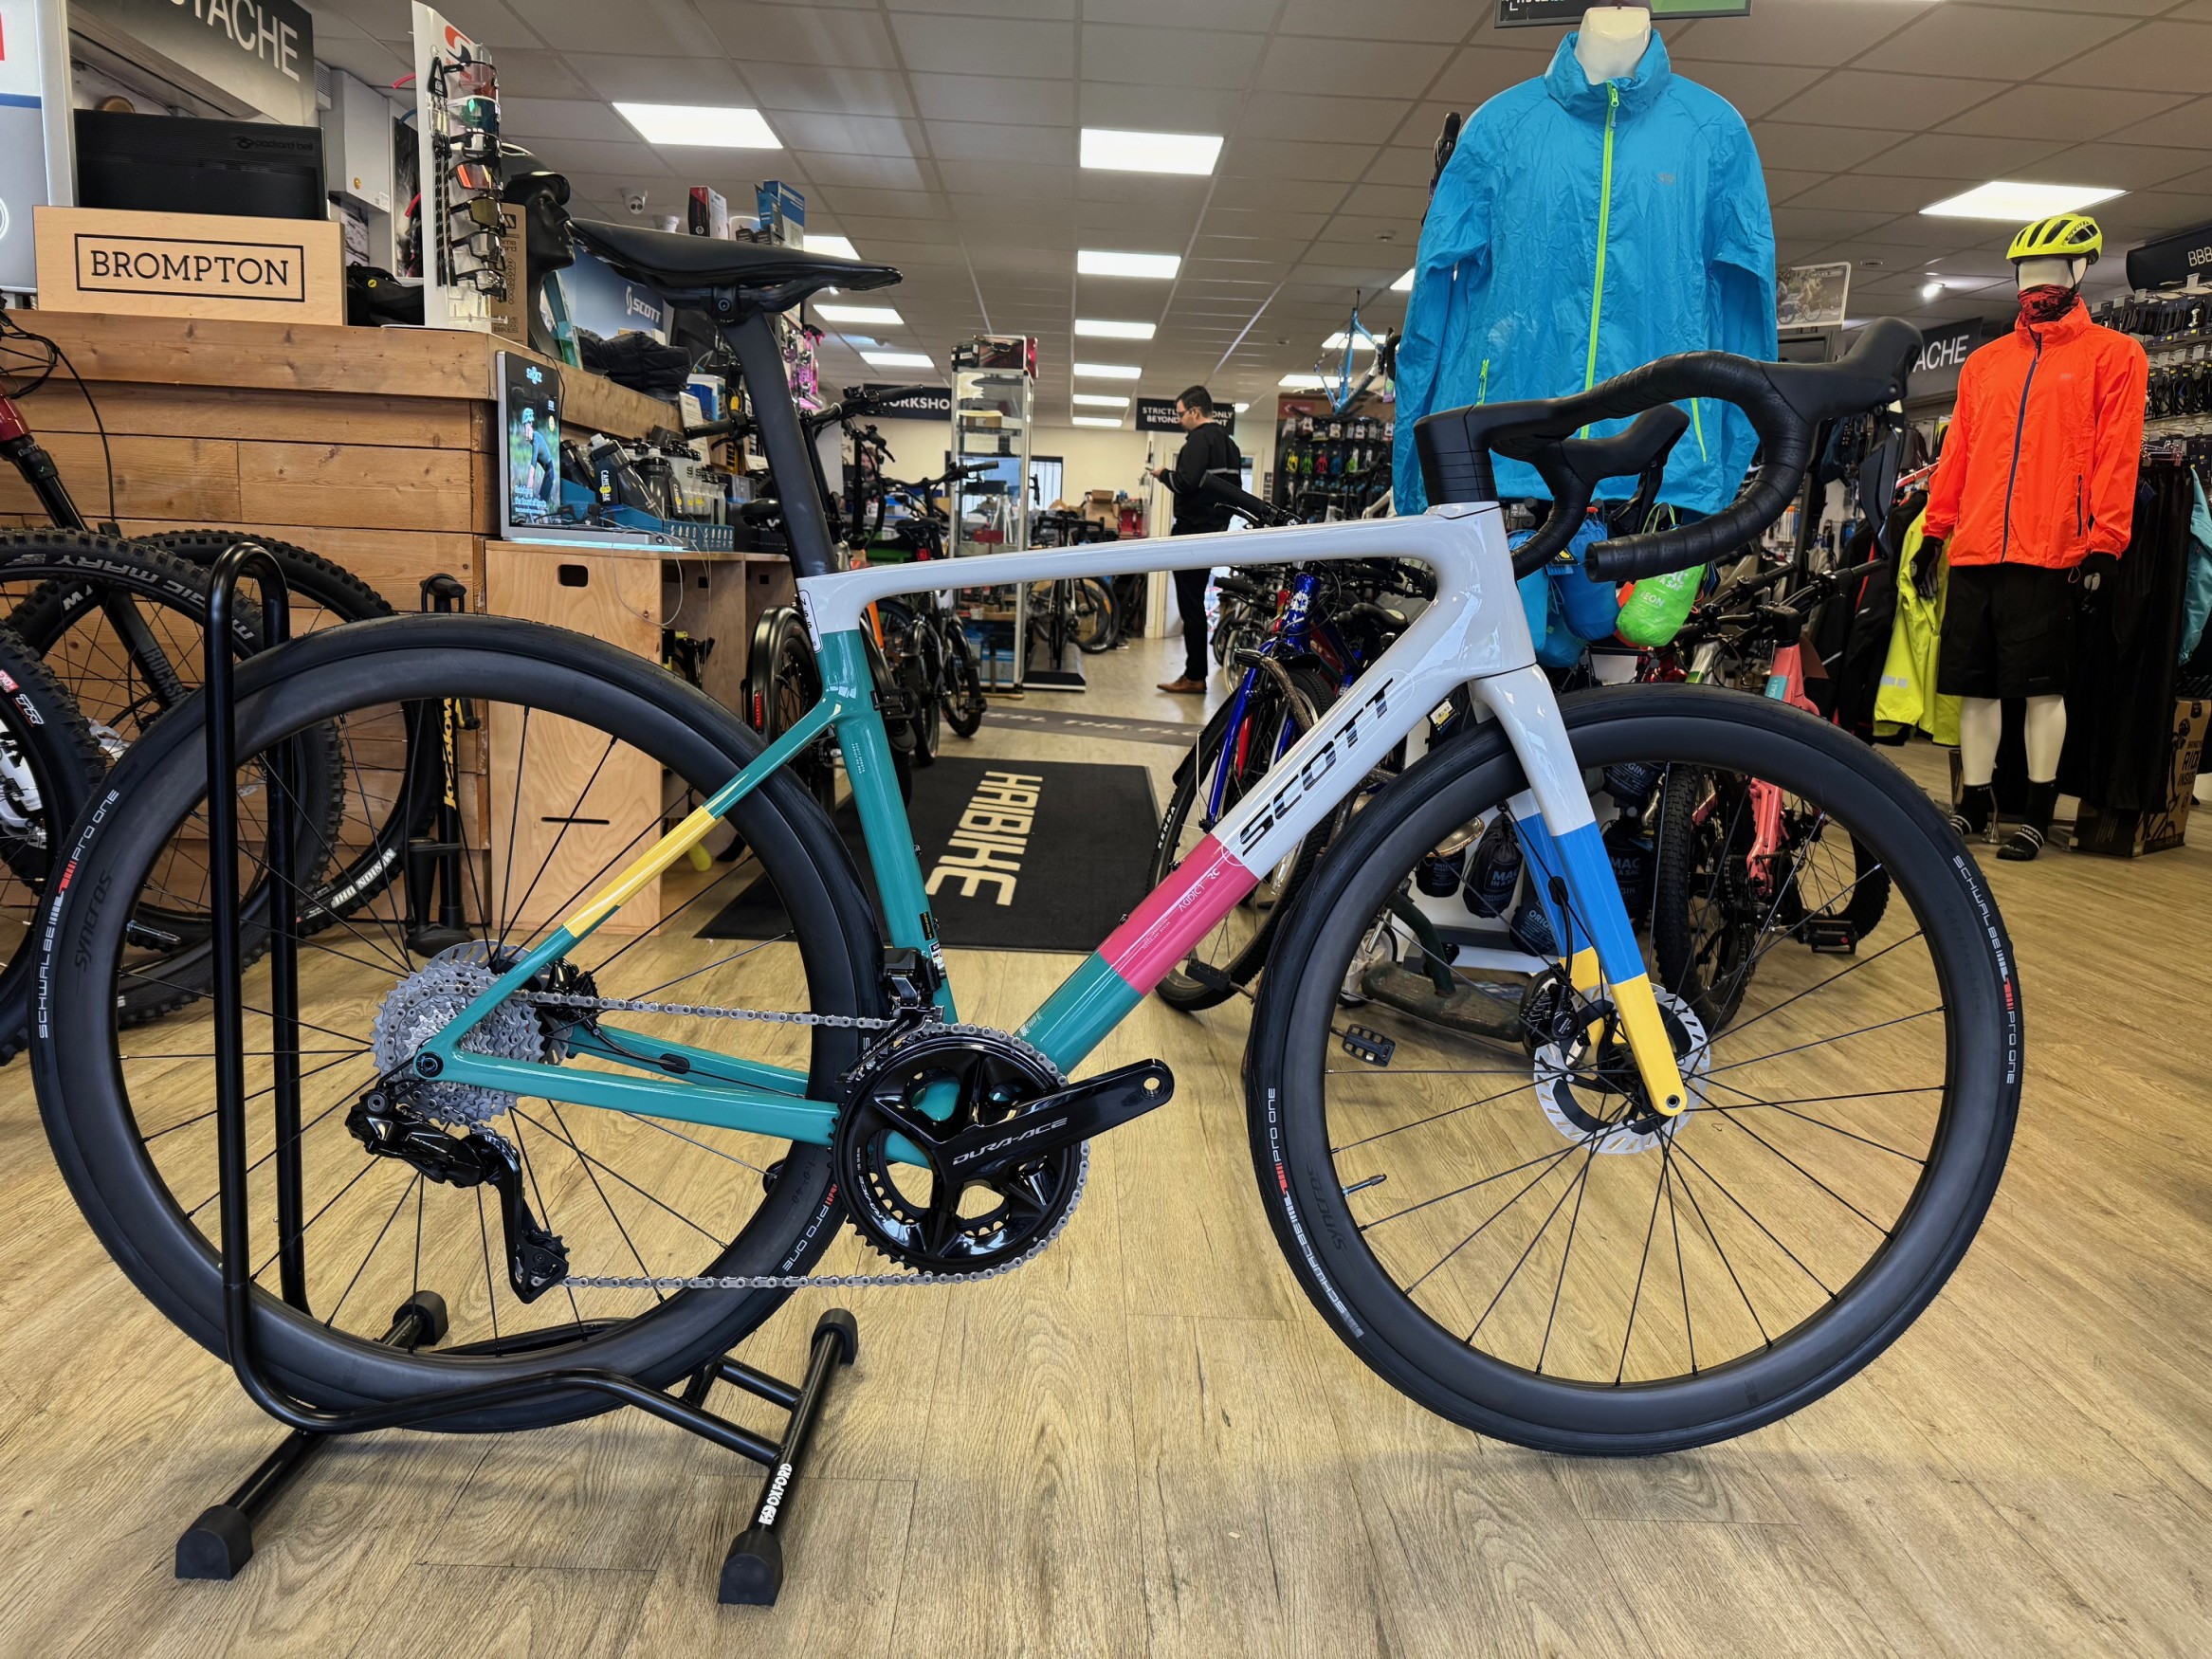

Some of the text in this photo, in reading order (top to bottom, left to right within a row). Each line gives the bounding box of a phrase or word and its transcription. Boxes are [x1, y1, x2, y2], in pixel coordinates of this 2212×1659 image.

[91, 249, 289, 285] BROMPTON
[632, 298, 661, 323] SCOTT
[54, 554, 254, 641] MGIC MARY
[1239, 677, 1394, 857] SCOTT
[72, 789, 120, 862] PRO ONE
[925, 771, 1043, 906] HAIBIKE
[1158, 806, 1176, 849] KENDA
[74, 868, 113, 973] SYNCROS
[1178, 867, 1220, 912] ADDICT RC
[39, 925, 57, 1039] SCHWALBE
[1953, 854, 2017, 1085] SCHWALBE PRO ONE
[952, 1117, 1069, 1166] DURA-ACE
[1268, 1087, 1282, 1163] PRO ONE
[782, 1204, 830, 1272] PRO ONE
[1293, 1223, 1348, 1315] SCHWALBE
[766, 1463, 793, 1506] OXFORD
